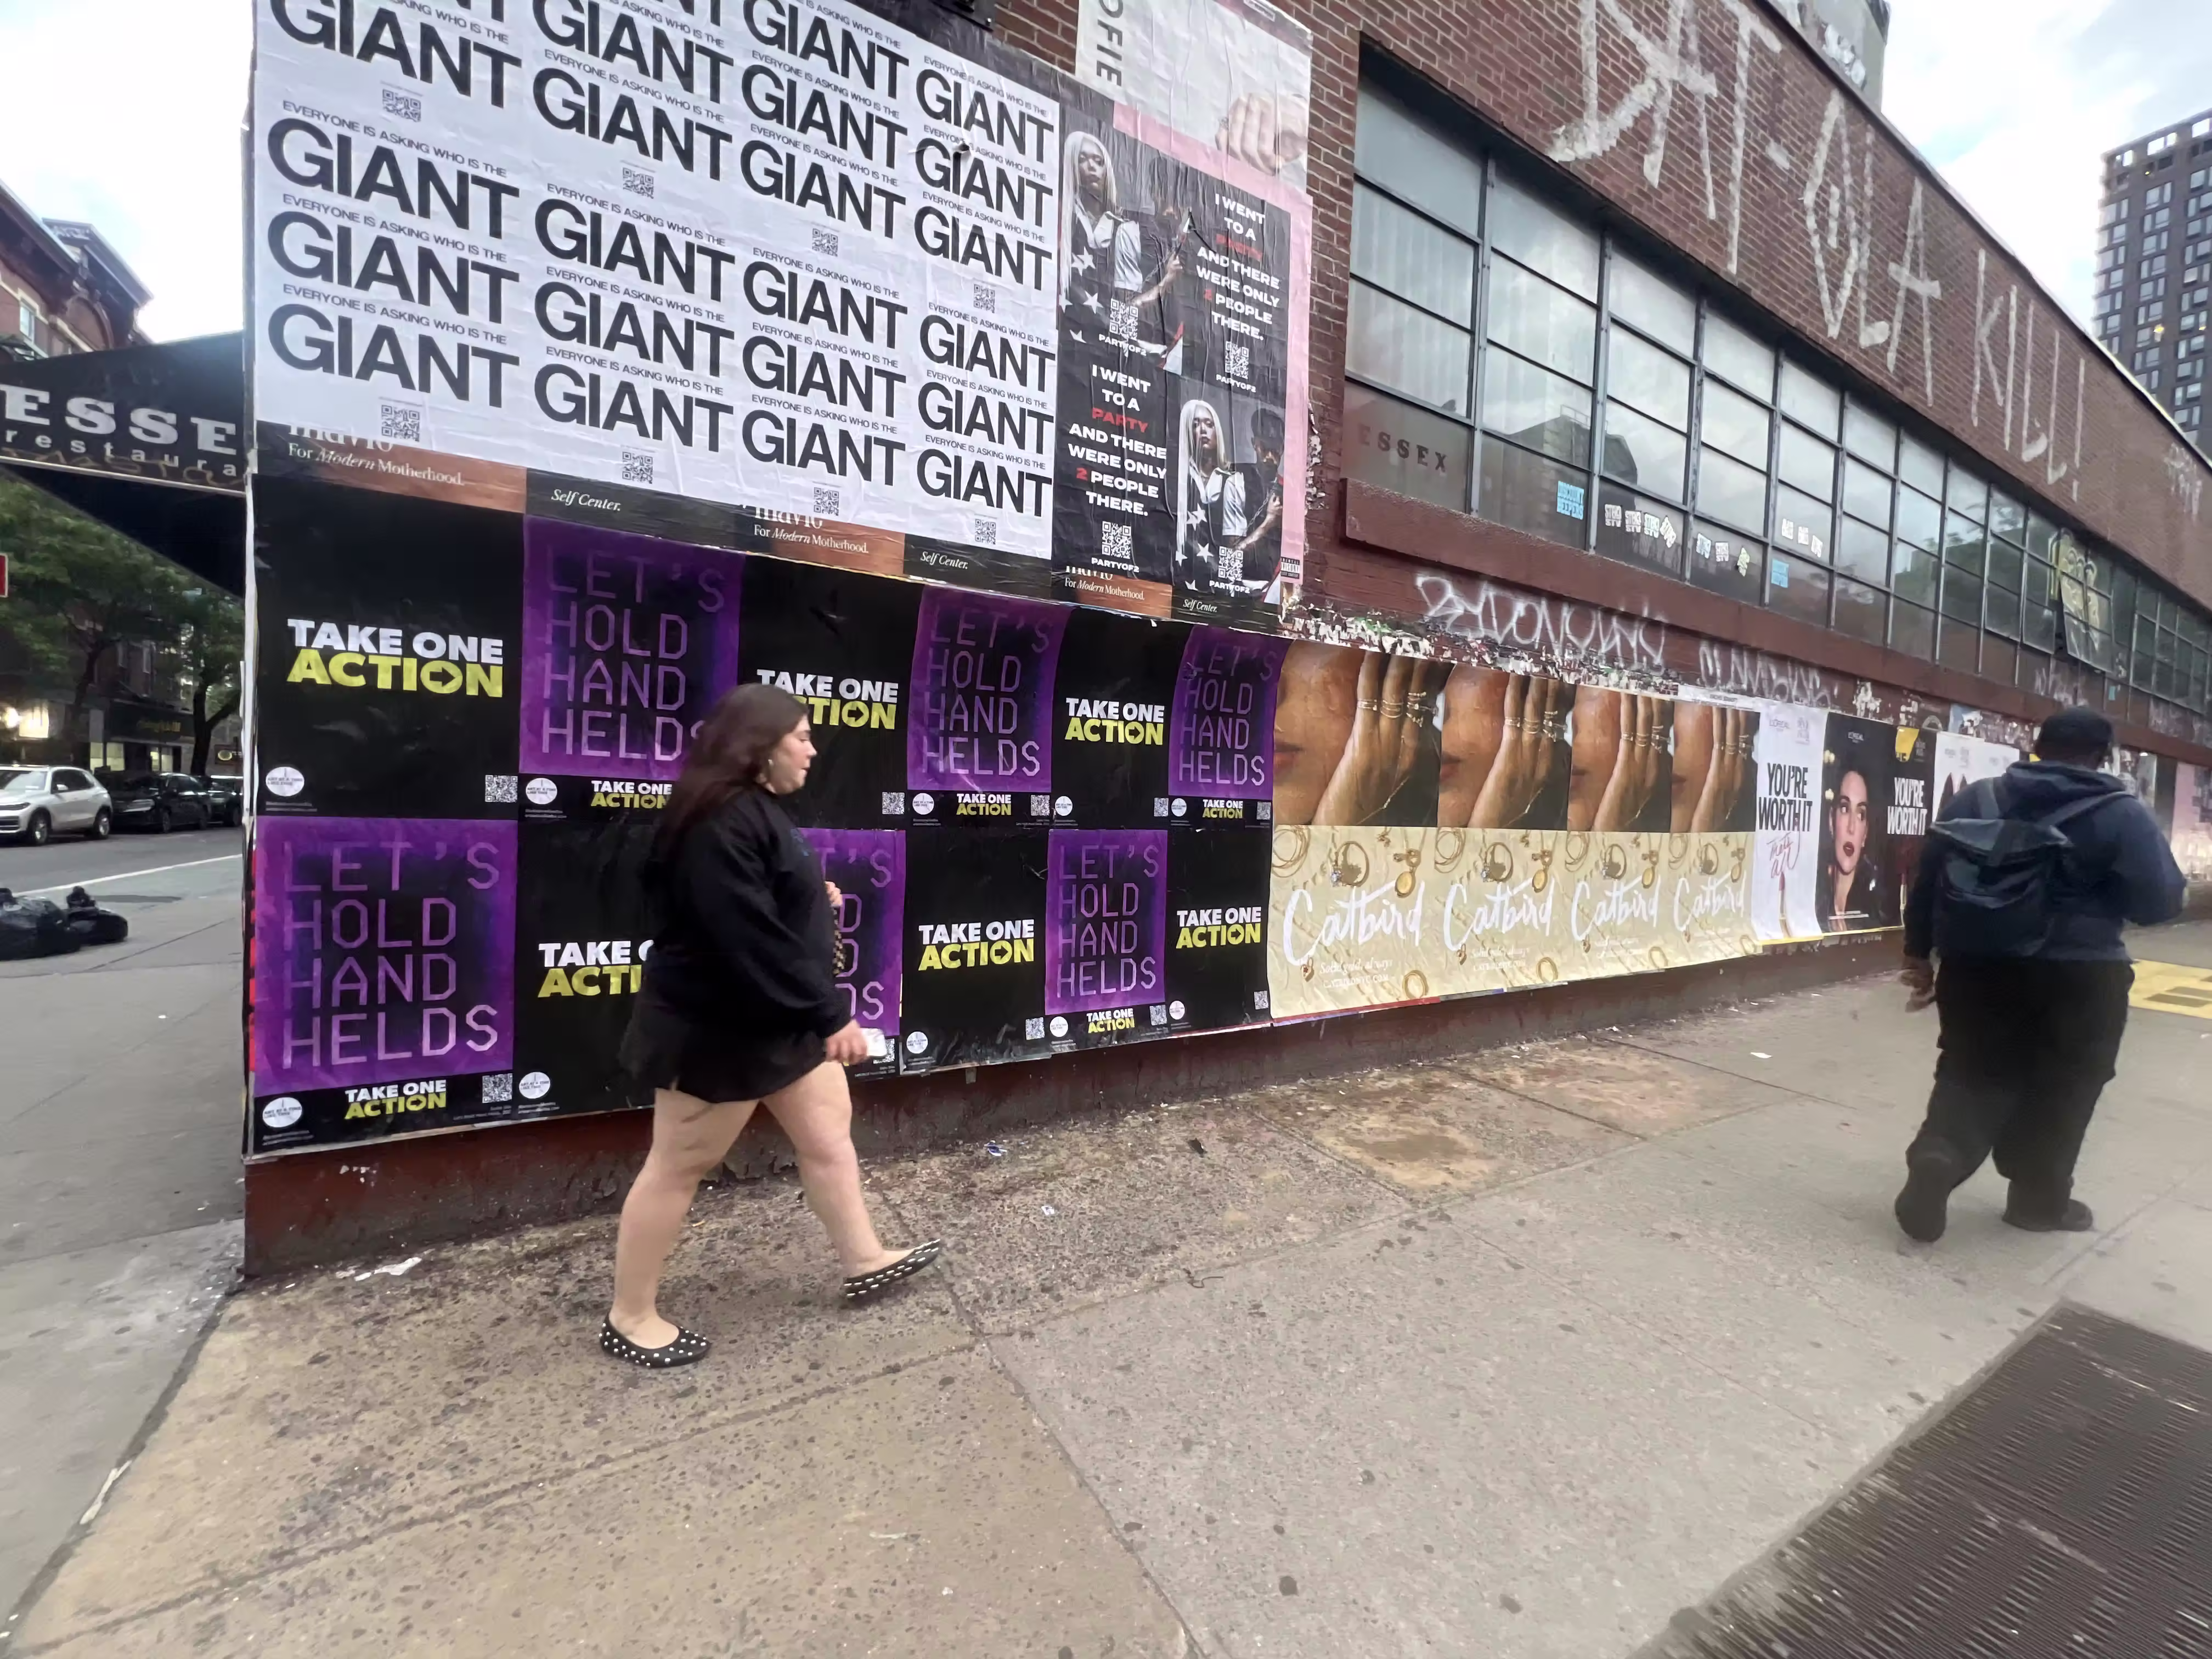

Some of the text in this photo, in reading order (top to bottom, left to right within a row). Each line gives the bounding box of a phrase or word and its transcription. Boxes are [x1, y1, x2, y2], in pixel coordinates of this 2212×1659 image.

[269, 0, 522, 108] GIANT
[533, 0, 733, 104] GIANT
[744, 0, 909, 99] GIANT
[533, 67, 733, 180] GIANT
[742, 64, 907, 169] GIANT
[916, 69, 1054, 163] GIANT
[283, 101, 507, 177] EVERYONE IS ASKING WHO IS THE
[267, 117, 520, 239] GIANT
[741, 140, 905, 238] GIANT
[916, 138, 1053, 227] GIANT
[1215, 194, 1265, 224] I WENT
[1224, 217, 1256, 241] TO A
[535, 199, 735, 302] GIANT
[915, 206, 1052, 291] GIANT
[1198, 246, 1229, 267] AND
[1232, 259, 1279, 287] THERE
[268, 211, 520, 324] GIANT
[1196, 266, 1280, 307] WERE ONLY
[743, 261, 907, 349] GIANT
[1216, 293, 1272, 324] PEOPLE
[535, 281, 734, 377] GIANT
[1212, 311, 1263, 340] THERE.
[268, 304, 520, 408] GIANT
[920, 315, 1056, 392] GIANT
[1099, 334, 1146, 356] PARTYOF2
[743, 335, 906, 417] GIANT
[1092, 364, 1151, 393] I WENT
[1216, 375, 1256, 392] PARTYOF2
[534, 363, 733, 452] GIANT
[752, 394, 802, 413] EVERYONE
[804, 407, 812, 415] IS
[815, 409, 847, 425] ASKING
[850, 417, 870, 429] WHO
[882, 425, 897, 435] THE
[918, 382, 1054, 454] GIANT
[1102, 389, 1139, 411] TO A
[0, 383, 236, 455] ESSE
[1092, 408, 1148, 433] PARTY
[5, 430, 236, 476] restaura
[742, 410, 905, 486] GIANT
[1069, 424, 1167, 459] AND THERE
[1358, 424, 1448, 472] ESSEX
[289, 443, 465, 486] For Modern Motherhood.
[1068, 443, 1166, 479] WERE ONLY
[551, 489, 620, 511] Self Center.
[917, 449, 1052, 517] GIANT
[1076, 467, 1158, 498] 2 PEOPLE
[1086, 491, 1148, 516] THERE.
[754, 524, 869, 554] For Modern Motherhood.
[546, 544, 724, 612] LET'S
[921, 551, 968, 569] Self Center.
[1091, 557, 1139, 573] PARTYOF2
[1065, 578, 1145, 600] For Modern Motherhood.
[1209, 580, 1250, 594] PARTYOF2
[1183, 599, 1217, 613] Self Center.
[287, 619, 503, 664] TAKE ONE
[545, 601, 687, 659] HOLD
[930, 606, 1052, 653] LET'S
[287, 648, 503, 697] ACTION
[544, 653, 685, 710] HAND
[757, 669, 898, 703] TAKE ONE
[927, 647, 1022, 692] HOLD
[793, 696, 896, 730] TION
[924, 692, 1018, 734] HAND
[1065, 698, 1164, 723] TAKE ONE
[1186, 678, 1253, 714] HOLD
[543, 707, 705, 760] HELD
[1065, 717, 1164, 745] ACTION
[1181, 714, 1250, 750] HAND
[922, 736, 1040, 776] HELDS
[1178, 751, 1265, 786] HELDS
[591, 781, 672, 794] TAKE ONE
[957, 794, 1011, 803] TAKE ONE
[1767, 763, 1808, 798] YOU'RE
[1894, 777, 1925, 807] YOU'RE
[957, 804, 1011, 816] ACTION
[1203, 799, 1243, 809] TAKE ONE
[1203, 809, 1243, 819] ACTION
[1759, 797, 1813, 832] WORTH IT
[1887, 806, 1927, 836] WORTH IT
[284, 840, 499, 891] LET'S
[816, 848, 891, 887] T'S
[1059, 845, 1159, 878] LET'S
[1059, 883, 1138, 918] HOLD
[1177, 907, 1261, 927] TAKE ONE
[283, 898, 456, 950] HOLD
[918, 919, 1034, 945] TAKE ONE
[1059, 921, 1137, 958] HAND
[1176, 923, 1261, 949] ACTION
[538, 940, 631, 967] TAKE
[918, 940, 1034, 970] ACTION
[283, 953, 456, 1008] HAND
[538, 964, 642, 997] ACTI
[1057, 957, 1156, 997] HELDS
[1087, 1009, 1133, 1022] TAKE ONE
[1088, 1018, 1135, 1032] ACTION
[283, 1005, 498, 1068] HELDS
[345, 1080, 447, 1103] TAKE ONE
[345, 1092, 446, 1119] ACTION
